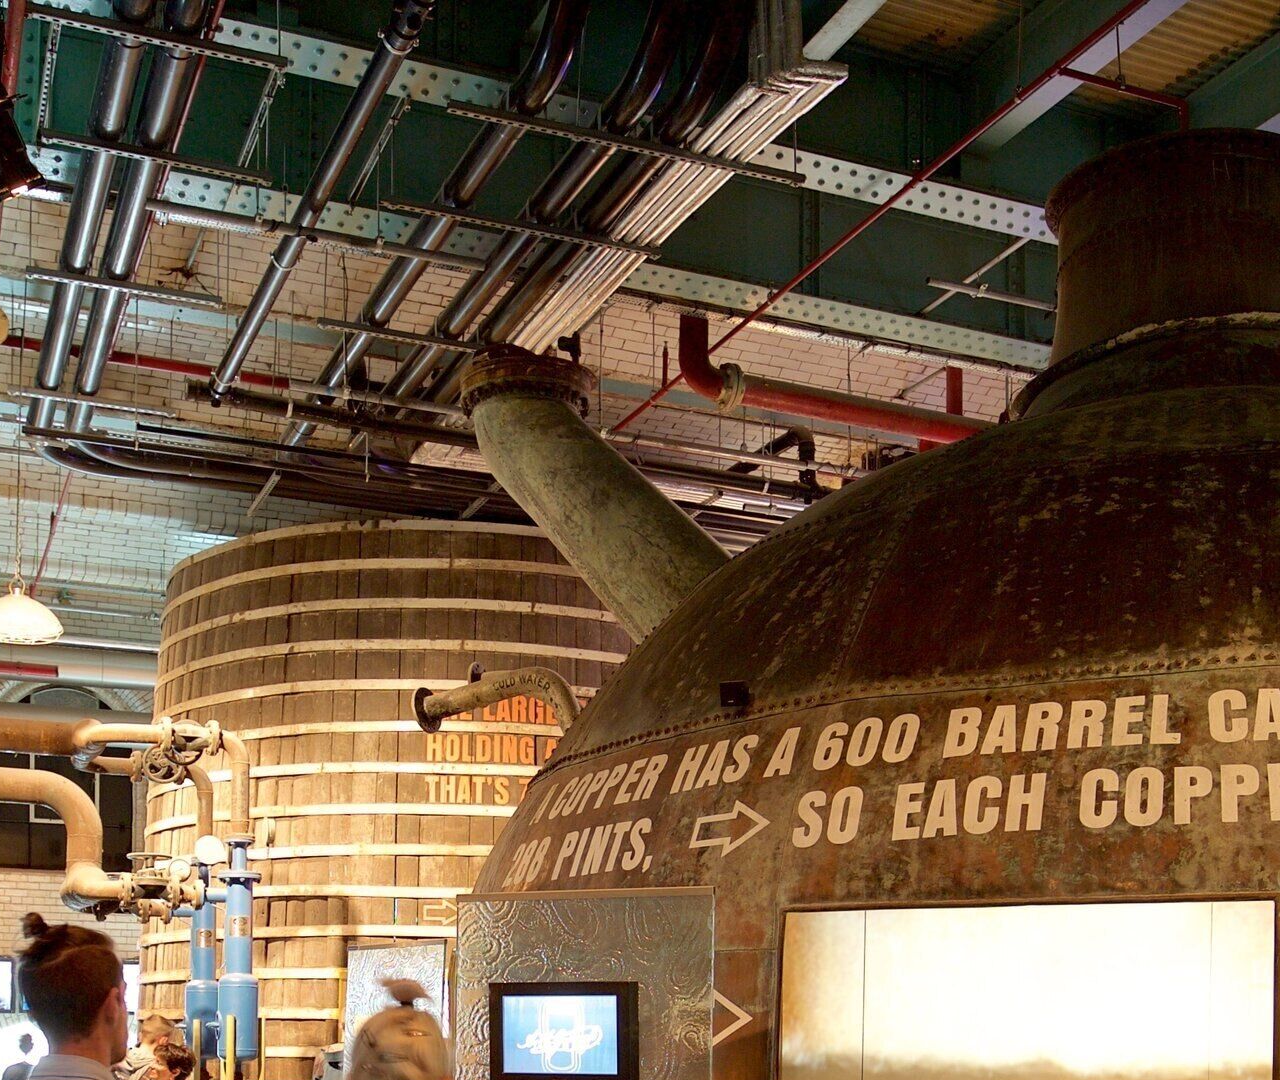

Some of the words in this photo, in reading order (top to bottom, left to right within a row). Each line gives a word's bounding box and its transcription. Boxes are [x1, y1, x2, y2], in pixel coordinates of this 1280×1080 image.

[426, 733, 535, 766] HOLDING
[529, 783, 559, 826] A
[548, 753, 669, 820] COPPER
[670, 734, 760, 795] HAS
[763, 726, 802, 778] A
[812, 713, 921, 771] 600
[942, 693, 1181, 759] BARREL
[425, 775, 511, 806] THAT'S
[501, 836, 552, 889] 288
[551, 817, 654, 882] PINTS,
[792, 785, 864, 848] SO
[891, 772, 1047, 842] EACH
